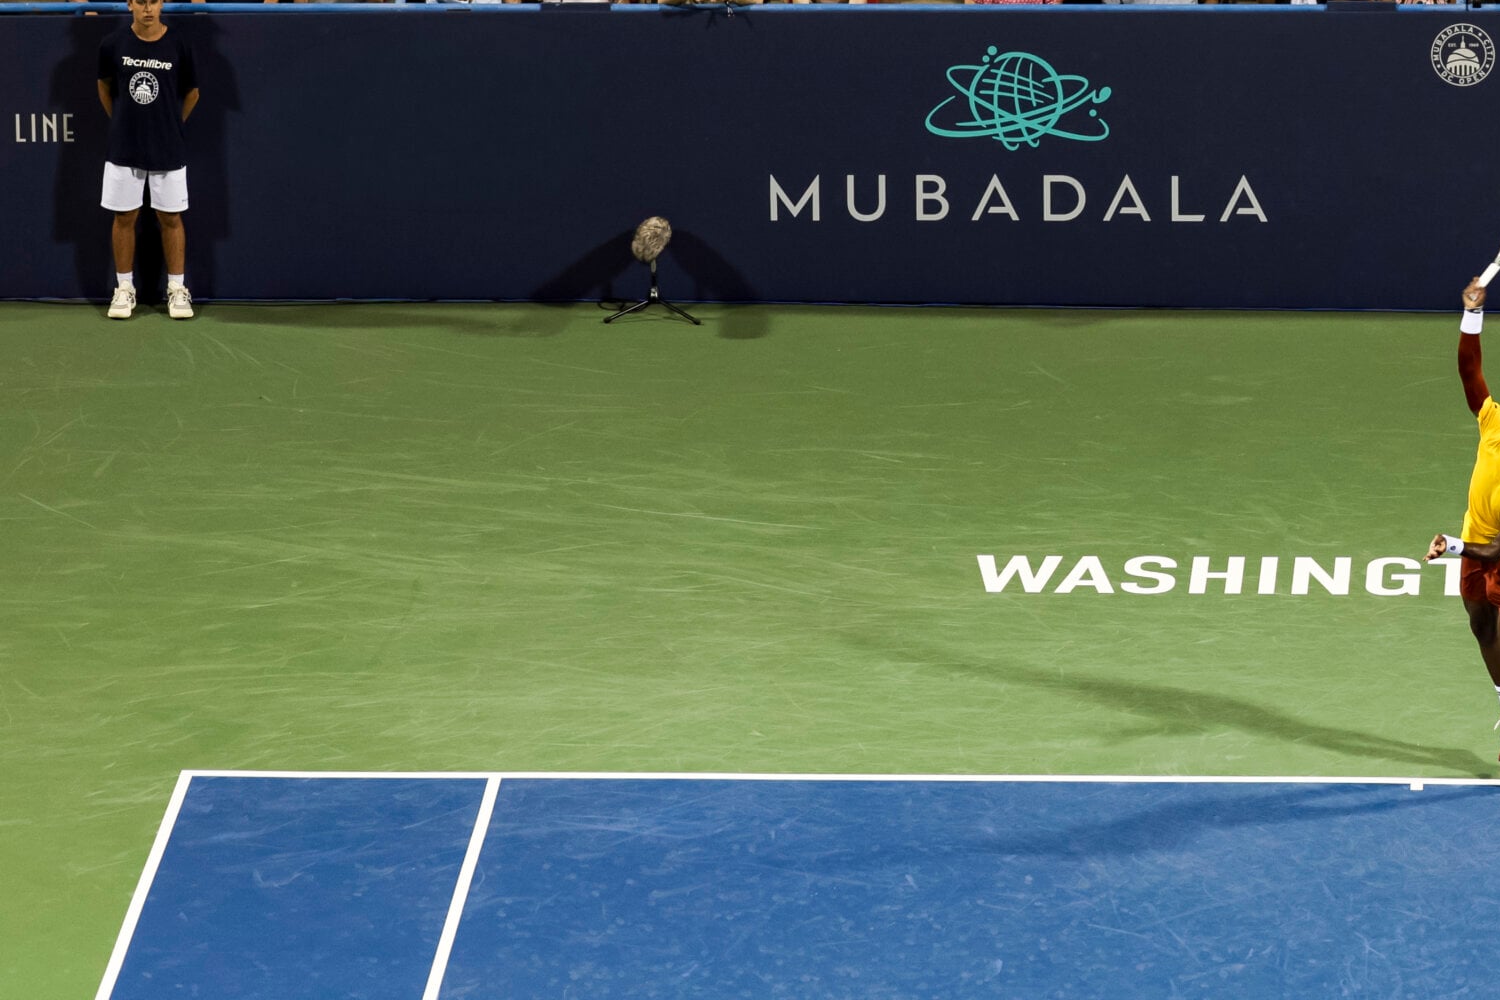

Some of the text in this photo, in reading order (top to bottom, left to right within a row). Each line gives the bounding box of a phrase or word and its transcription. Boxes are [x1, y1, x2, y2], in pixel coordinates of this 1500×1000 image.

[1433, 25, 1494, 61] MUBADALA CITI
[122, 56, 173, 71] Tecnifibre
[1441, 70, 1487, 85] DC OPEN
[15, 113, 75, 143] LINE
[769, 174, 1268, 223] MUBADALA
